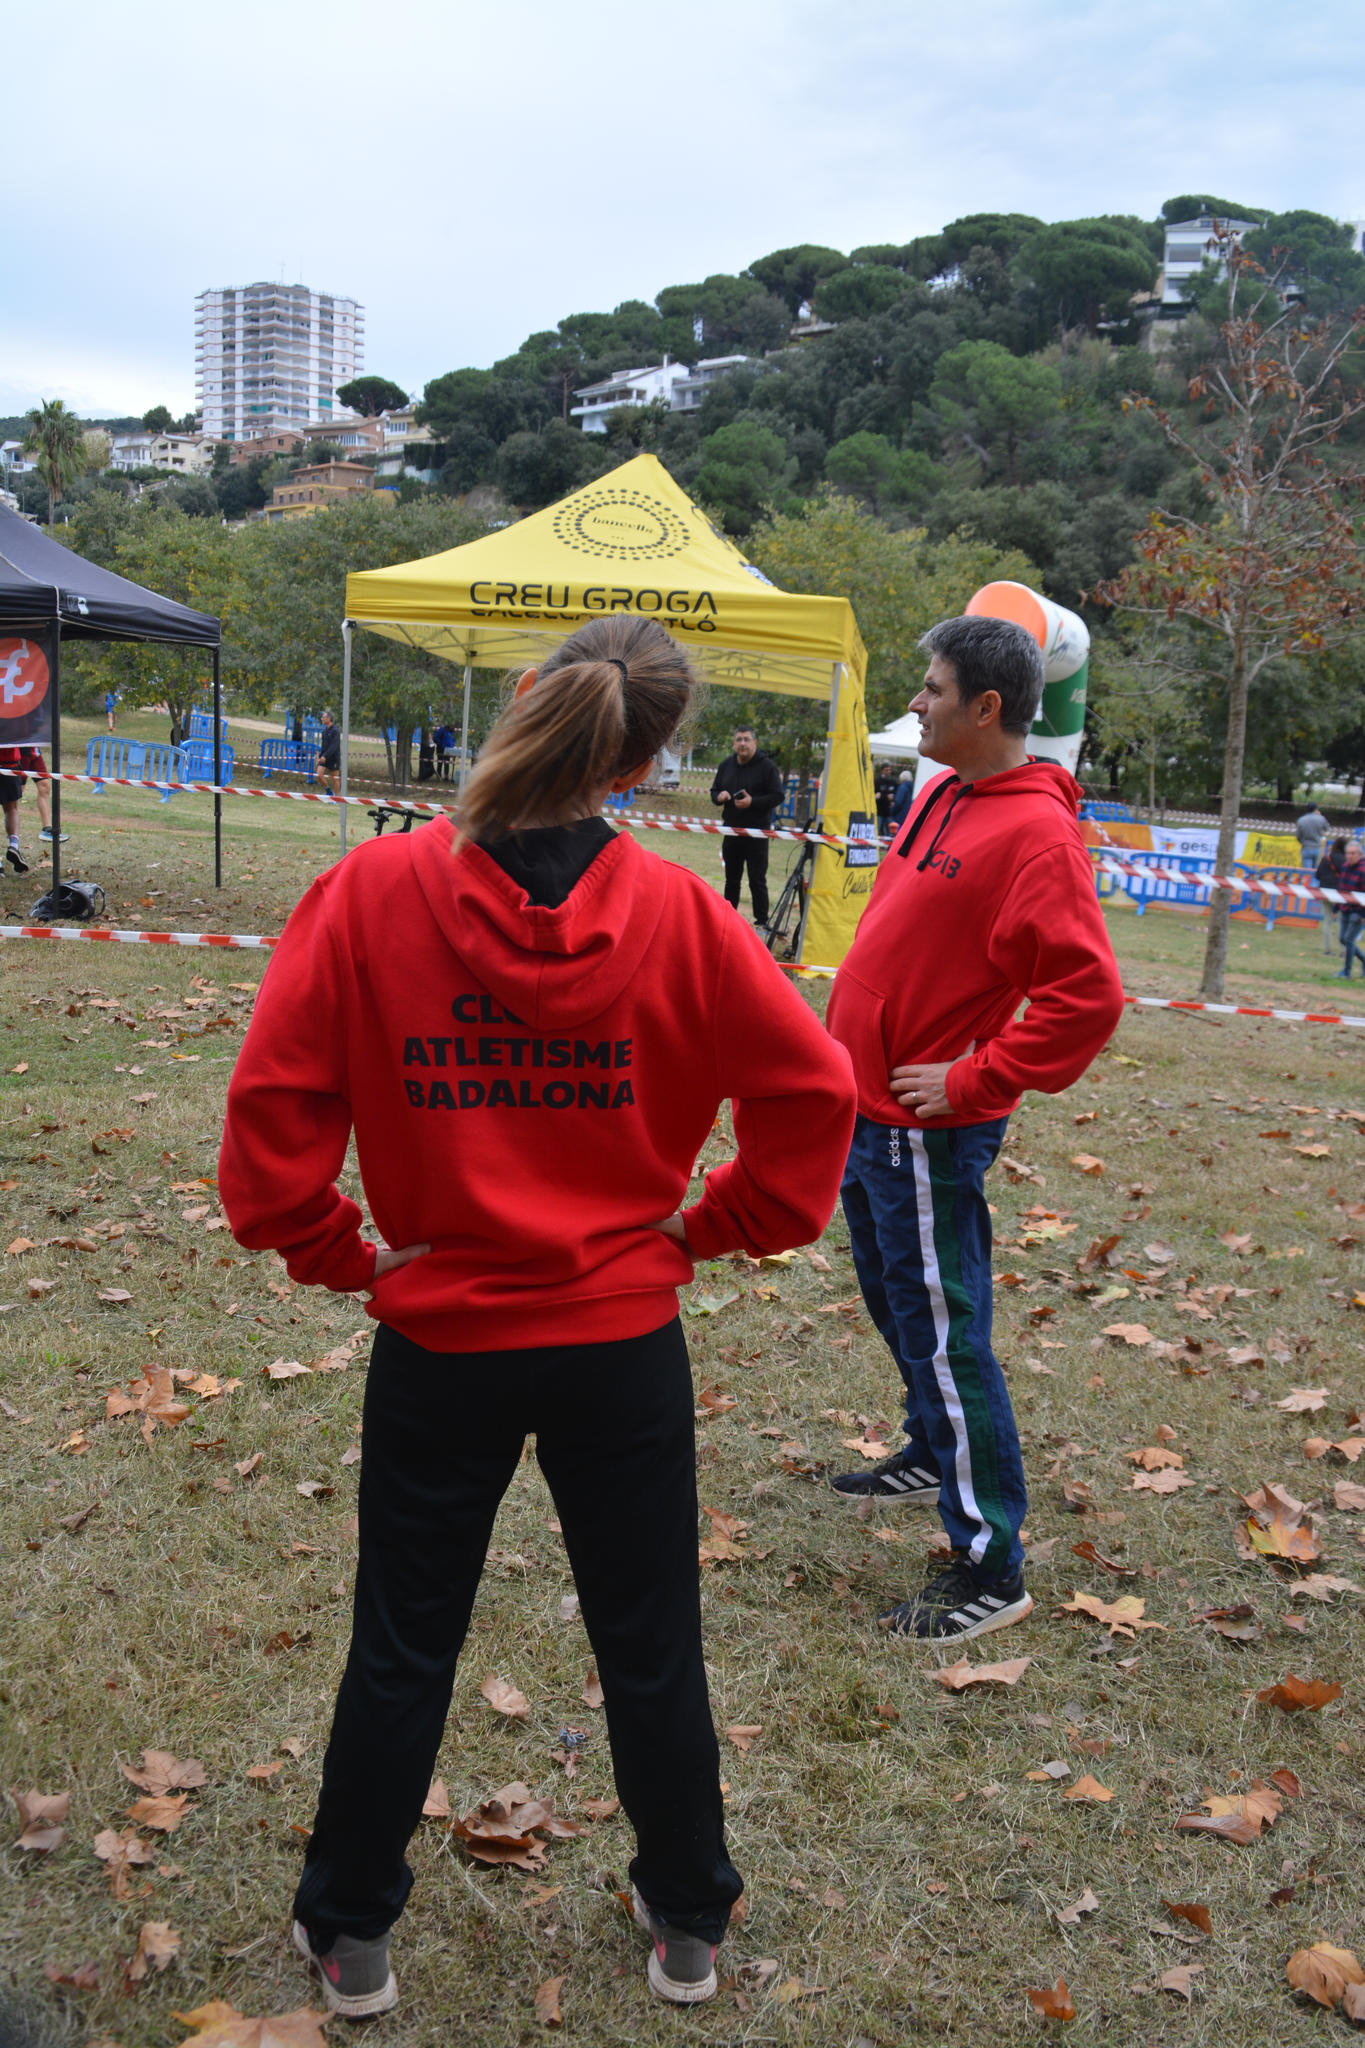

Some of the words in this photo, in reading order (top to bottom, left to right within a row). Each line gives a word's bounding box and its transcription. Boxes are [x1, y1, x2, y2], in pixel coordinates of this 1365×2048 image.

[470, 581, 570, 608] CREU
[583, 587, 718, 615] GROGA
[403, 1037, 632, 1069] ATLETISME
[404, 1079, 635, 1110] BADALONA
[889, 1128, 900, 1167] adidas
